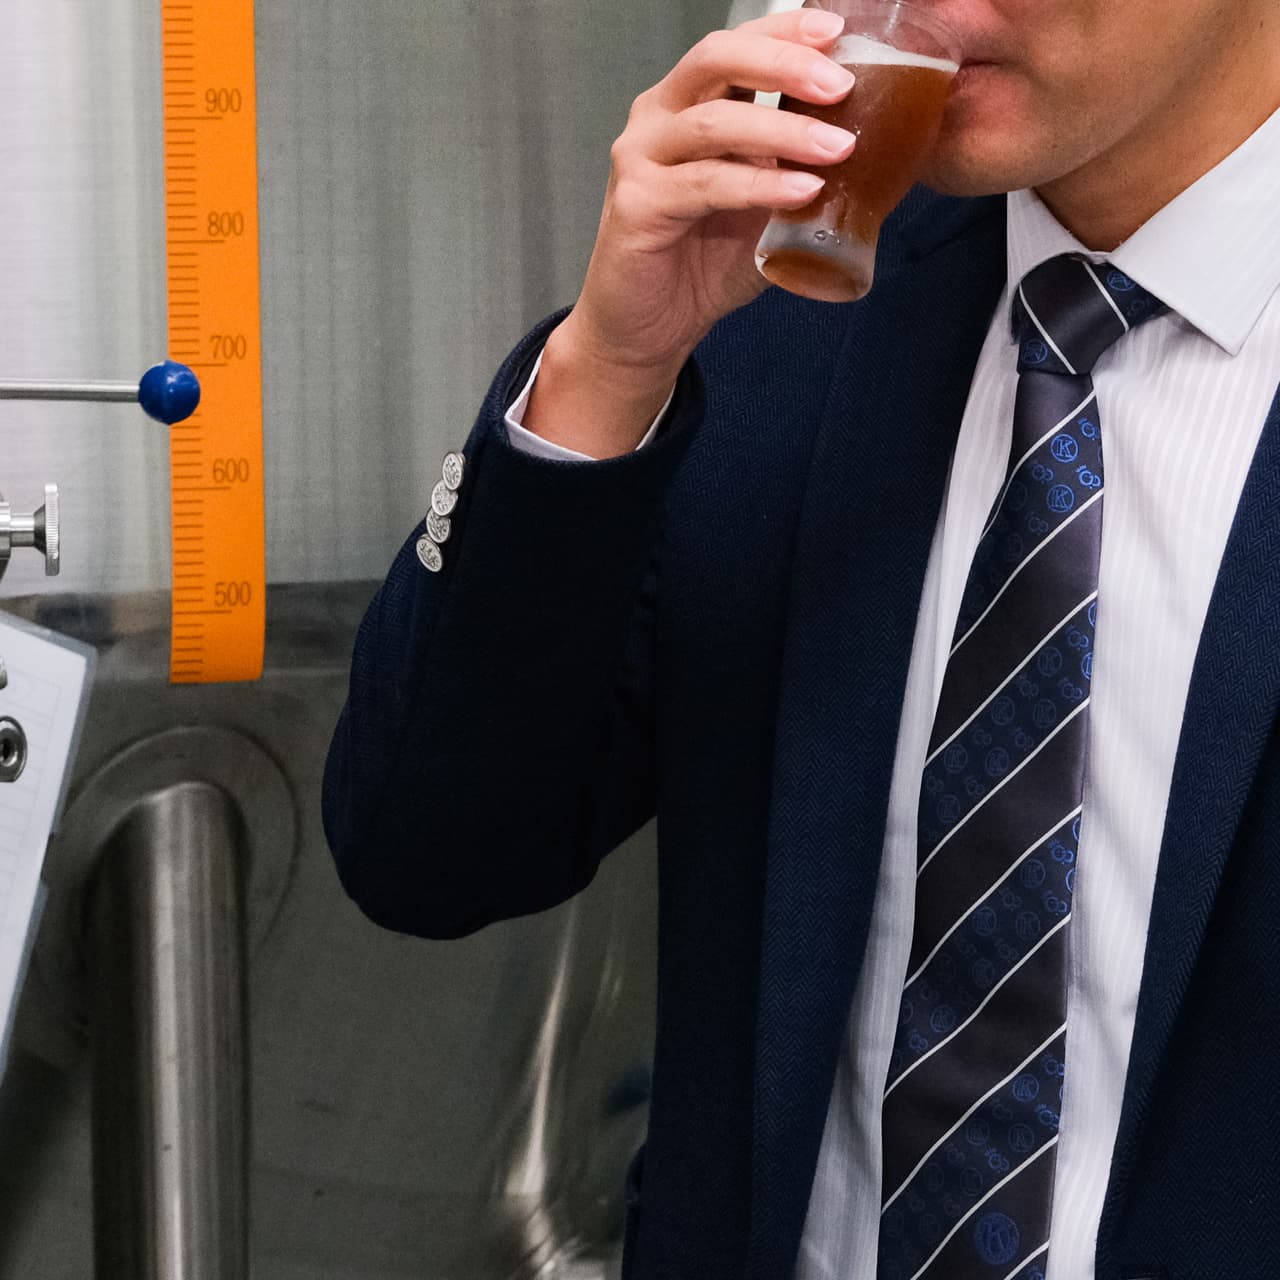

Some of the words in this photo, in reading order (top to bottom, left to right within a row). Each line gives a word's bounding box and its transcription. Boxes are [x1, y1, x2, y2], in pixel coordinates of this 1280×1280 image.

[204, 88, 241, 113] 900
[207, 211, 244, 237] 800
[209, 335, 246, 360] 700
[212, 458, 249, 483] 600
[214, 581, 251, 607] 500
